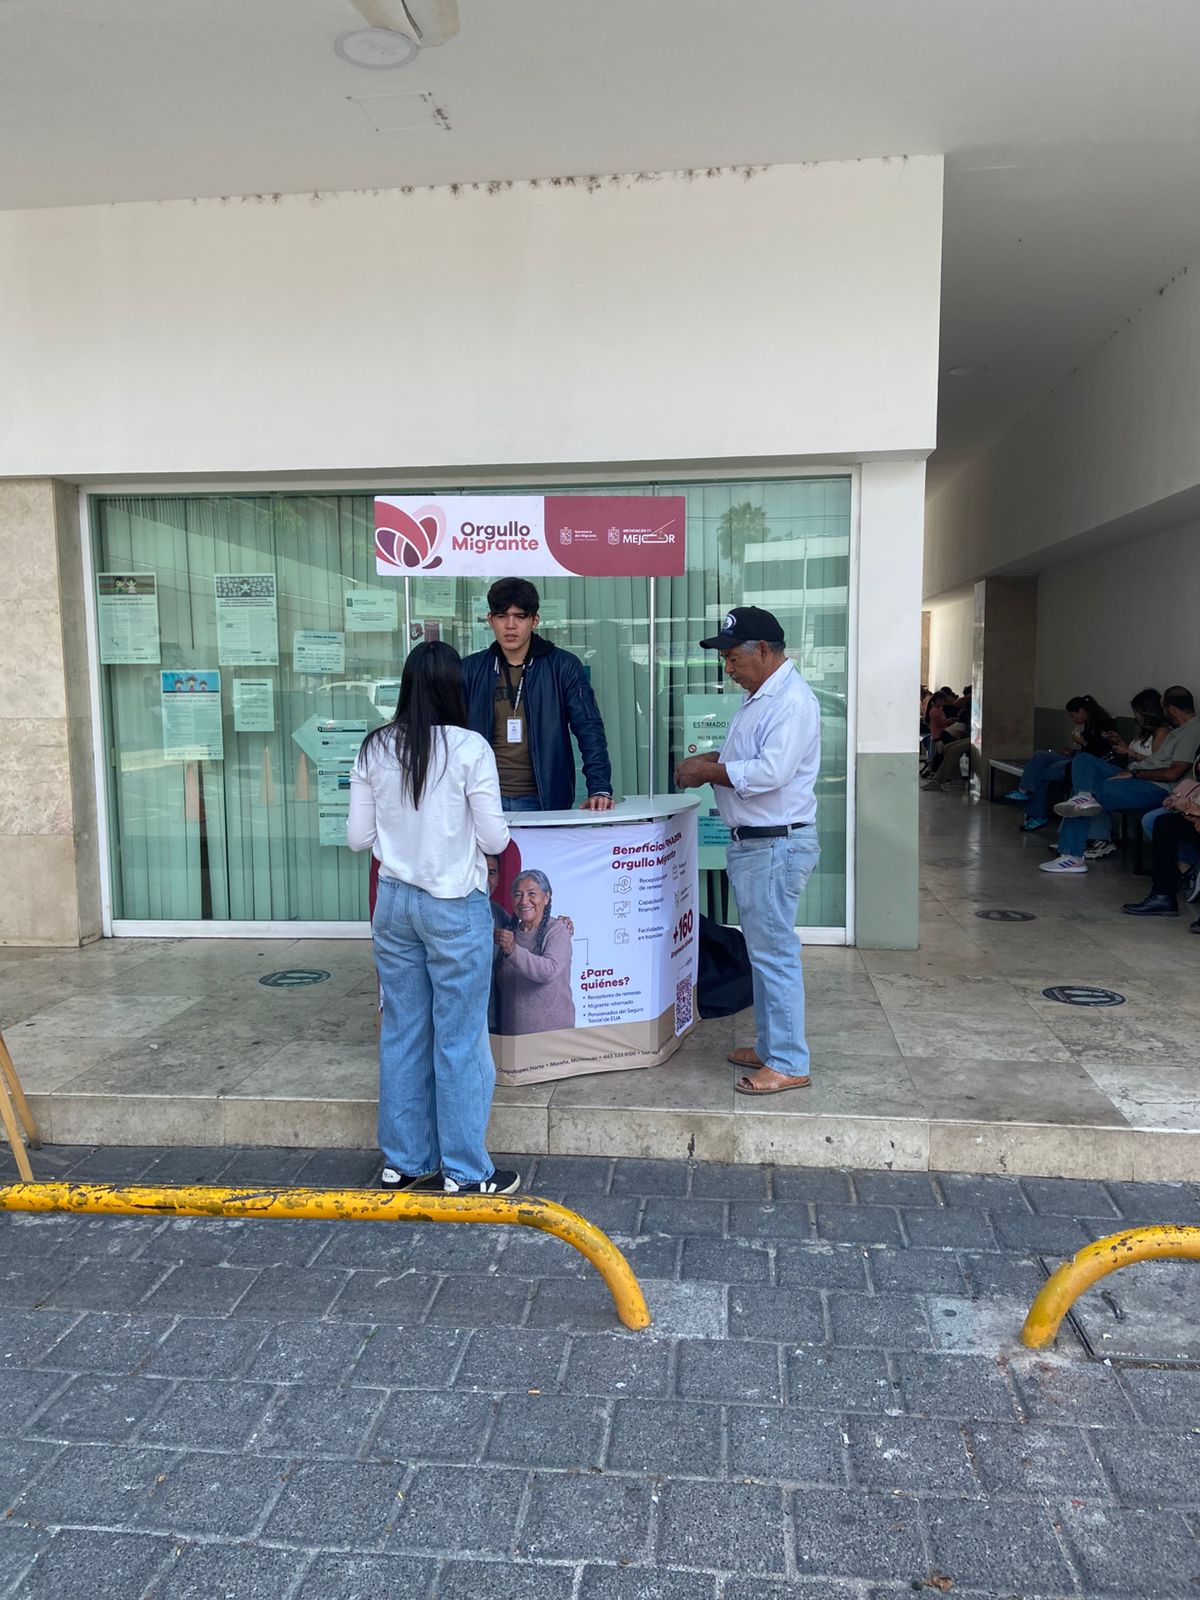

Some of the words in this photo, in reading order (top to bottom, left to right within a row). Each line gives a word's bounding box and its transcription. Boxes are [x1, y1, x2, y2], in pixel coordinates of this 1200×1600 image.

[460, 521, 531, 540] Orgullo
[452, 536, 539, 554] Migrante
[693, 721, 726, 729] ESTIMADO
[612, 857, 655, 871] Orgullo
[580, 968, 614, 980] ¿Para
[580, 976, 630, 991] quiénes?
[587, 993, 615, 1001] Receptores
[587, 1002, 610, 1010] Migrante
[587, 1010, 619, 1018] Pensionados
